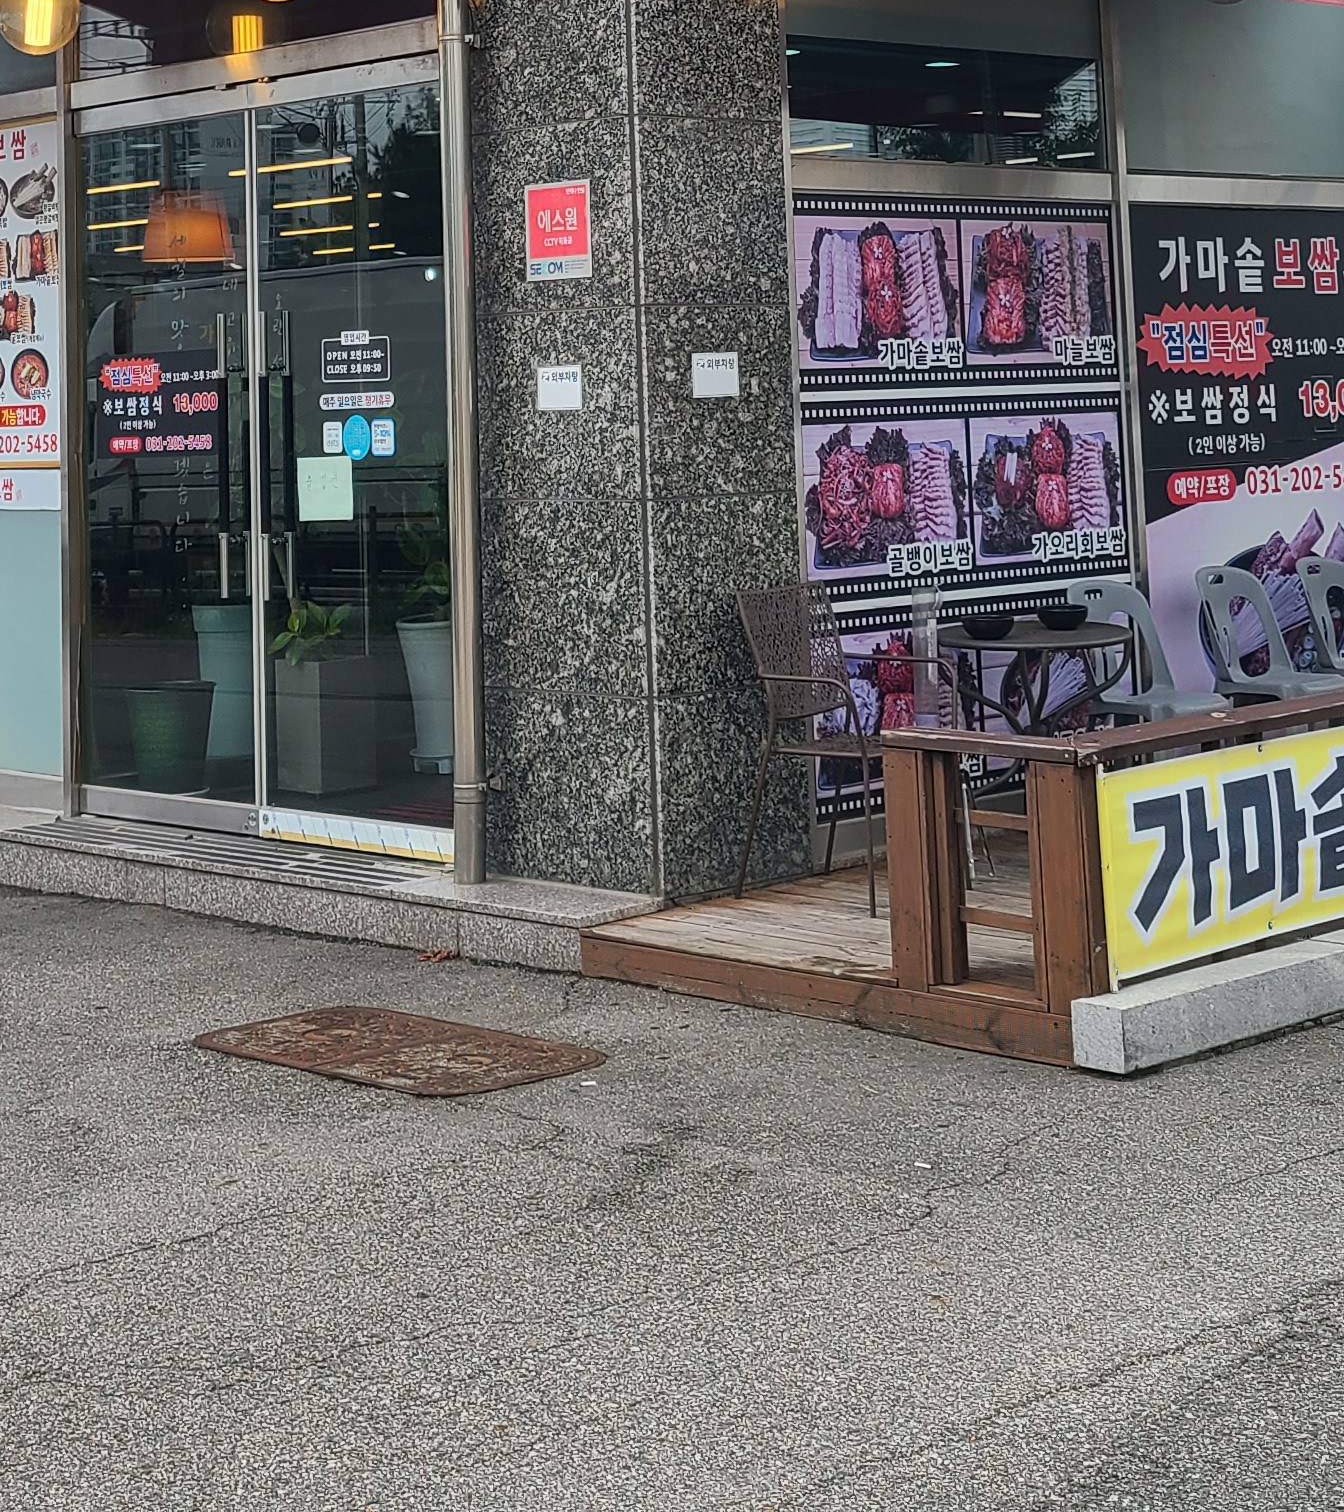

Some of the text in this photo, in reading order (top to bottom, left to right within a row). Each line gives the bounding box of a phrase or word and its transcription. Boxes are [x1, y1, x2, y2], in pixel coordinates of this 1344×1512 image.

[537, 207, 579, 233] 에스원
[1158, 236, 1341, 295] 가마솥보쌈
[343, 332, 367, 343] 영업시간
[1149, 319, 1266, 364] "점심특선"
[1271, 339, 1294, 358] 오전
[1295, 338, 1328, 356] 11:00
[326, 350, 348, 361] OPEN
[349, 349, 362, 361] 오전
[878, 338, 964, 370] 가마솥보쌈
[1055, 335, 1116, 365] 마늘보쌈
[326, 364, 348, 374] CLOSE
[349, 363, 362, 375] 오후
[706, 357, 735, 370] 외부차량
[160, 371, 172, 383] 오전
[172, 371, 189, 382] 11:00
[551, 370, 579, 384] 외부차량
[172, 392, 219, 416] 13,000
[322, 396, 336, 408] 매주
[365, 393, 391, 406] 정기휴무
[145, 433, 213, 453] 031-202-5458
[1216, 435, 1238, 455] 이상
[1239, 433, 1266, 453] 가능)
[1174, 473, 1230, 499] 예약/포장
[1032, 528, 1126, 562] 가오리회보쌈
[887, 539, 974, 576] 골뱅이보쌈
